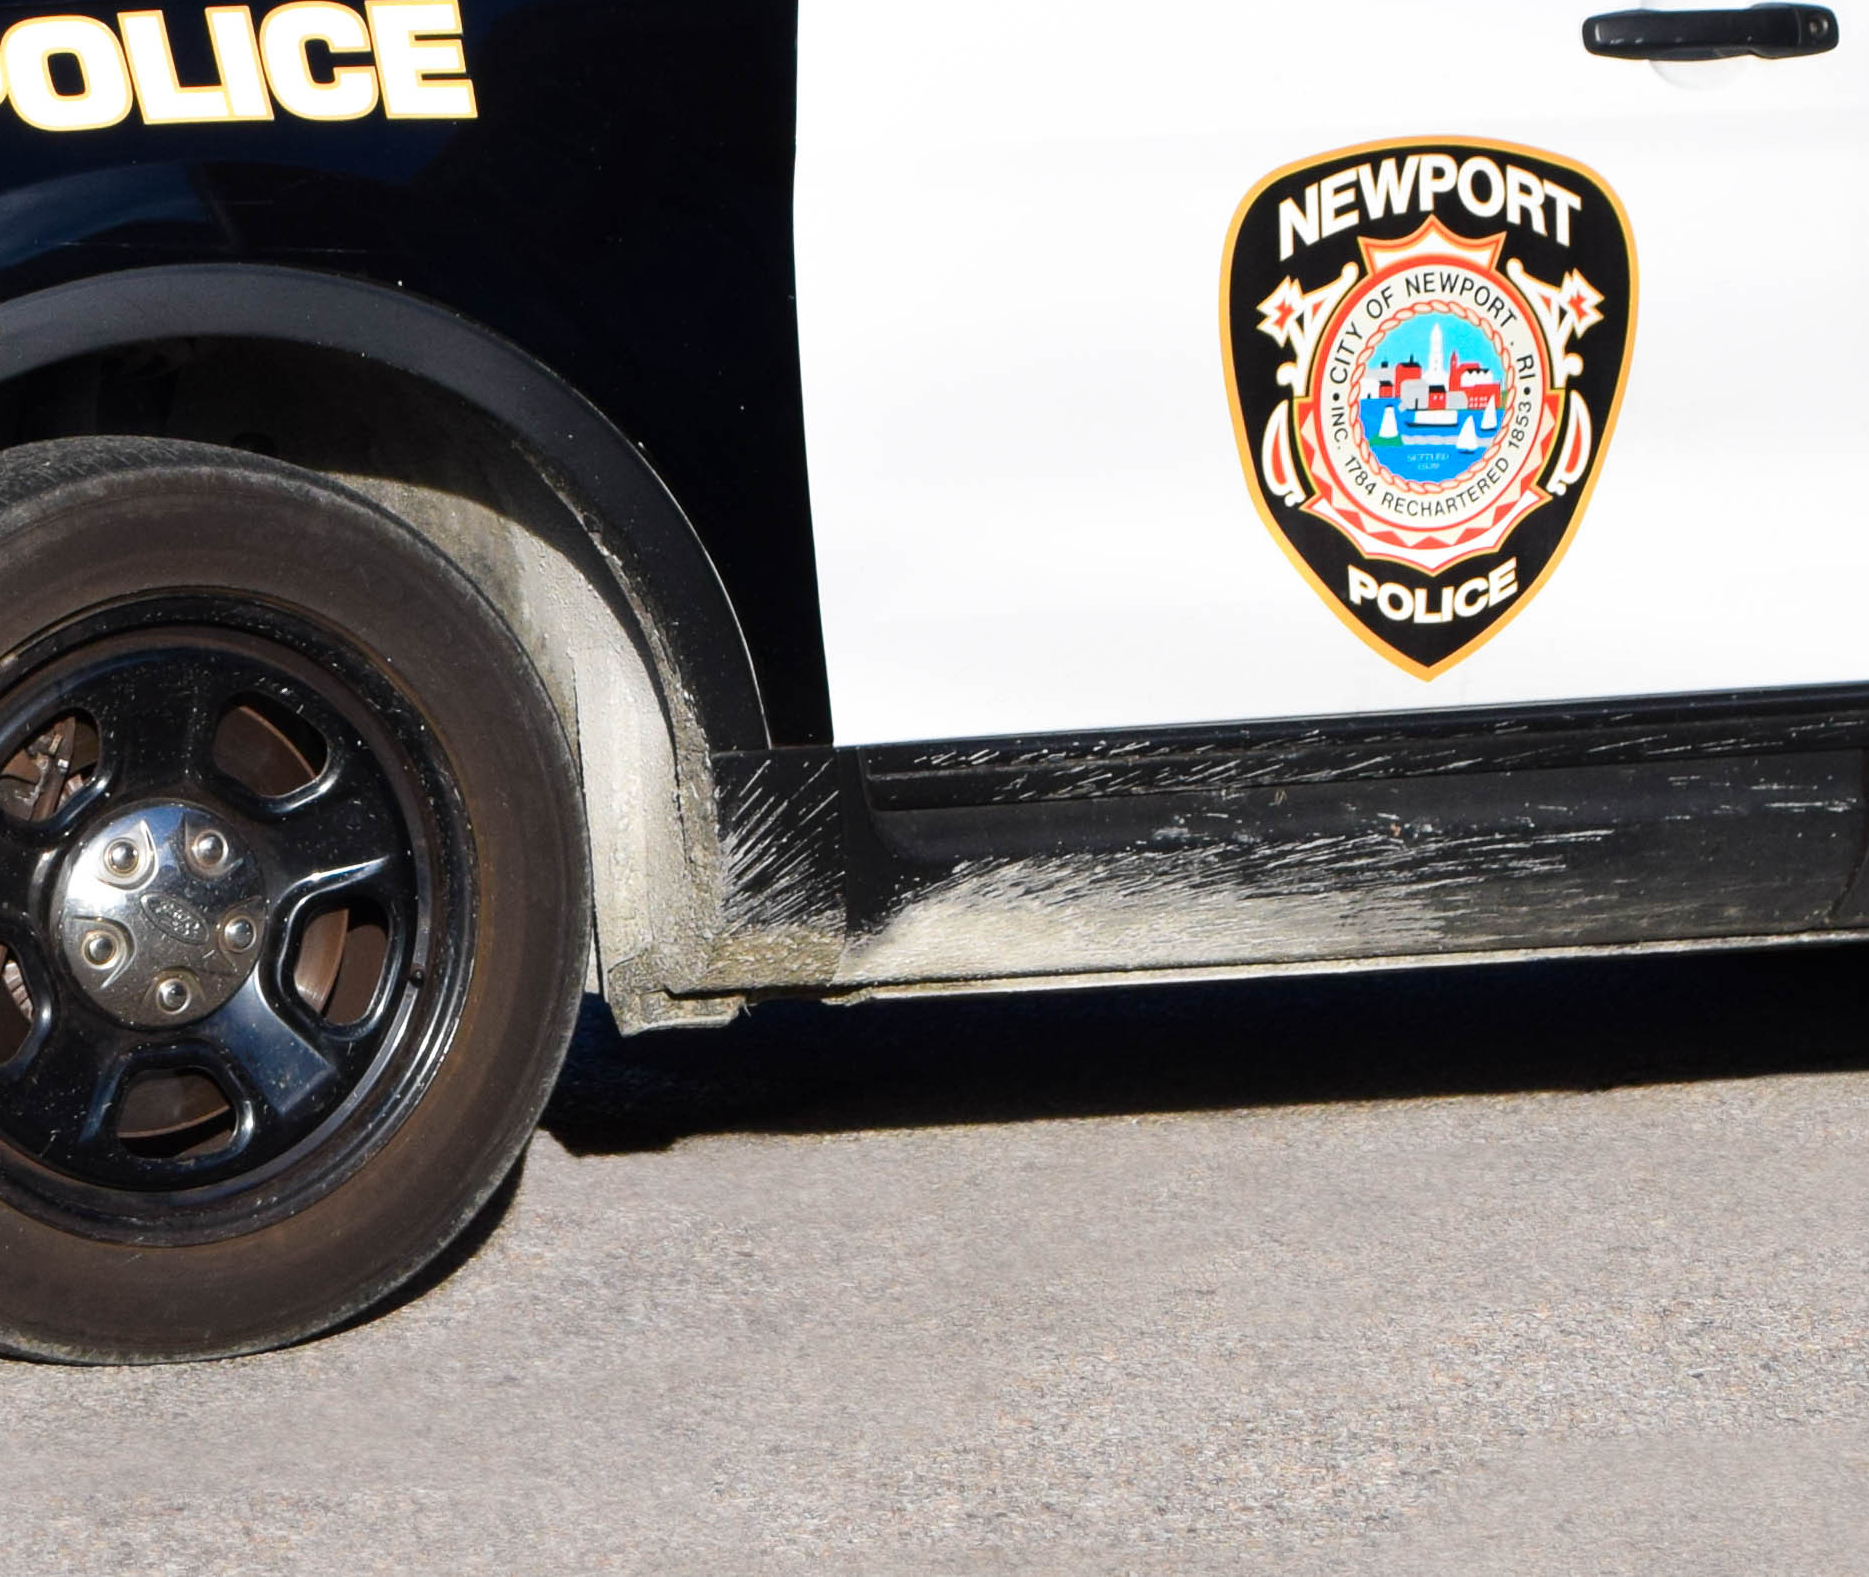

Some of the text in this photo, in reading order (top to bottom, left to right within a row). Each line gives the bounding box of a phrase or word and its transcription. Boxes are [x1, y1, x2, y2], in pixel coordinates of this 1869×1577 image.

[1278, 153, 1582, 262] NEWPORT
[1330, 272, 1536, 384] CITY OF NEWPORT RI
[1344, 456, 1378, 496] 1784
[1381, 457, 1509, 517] RECHARTERED
[1508, 401, 1532, 450] 1853
[1347, 556, 1518, 623] POLICE
